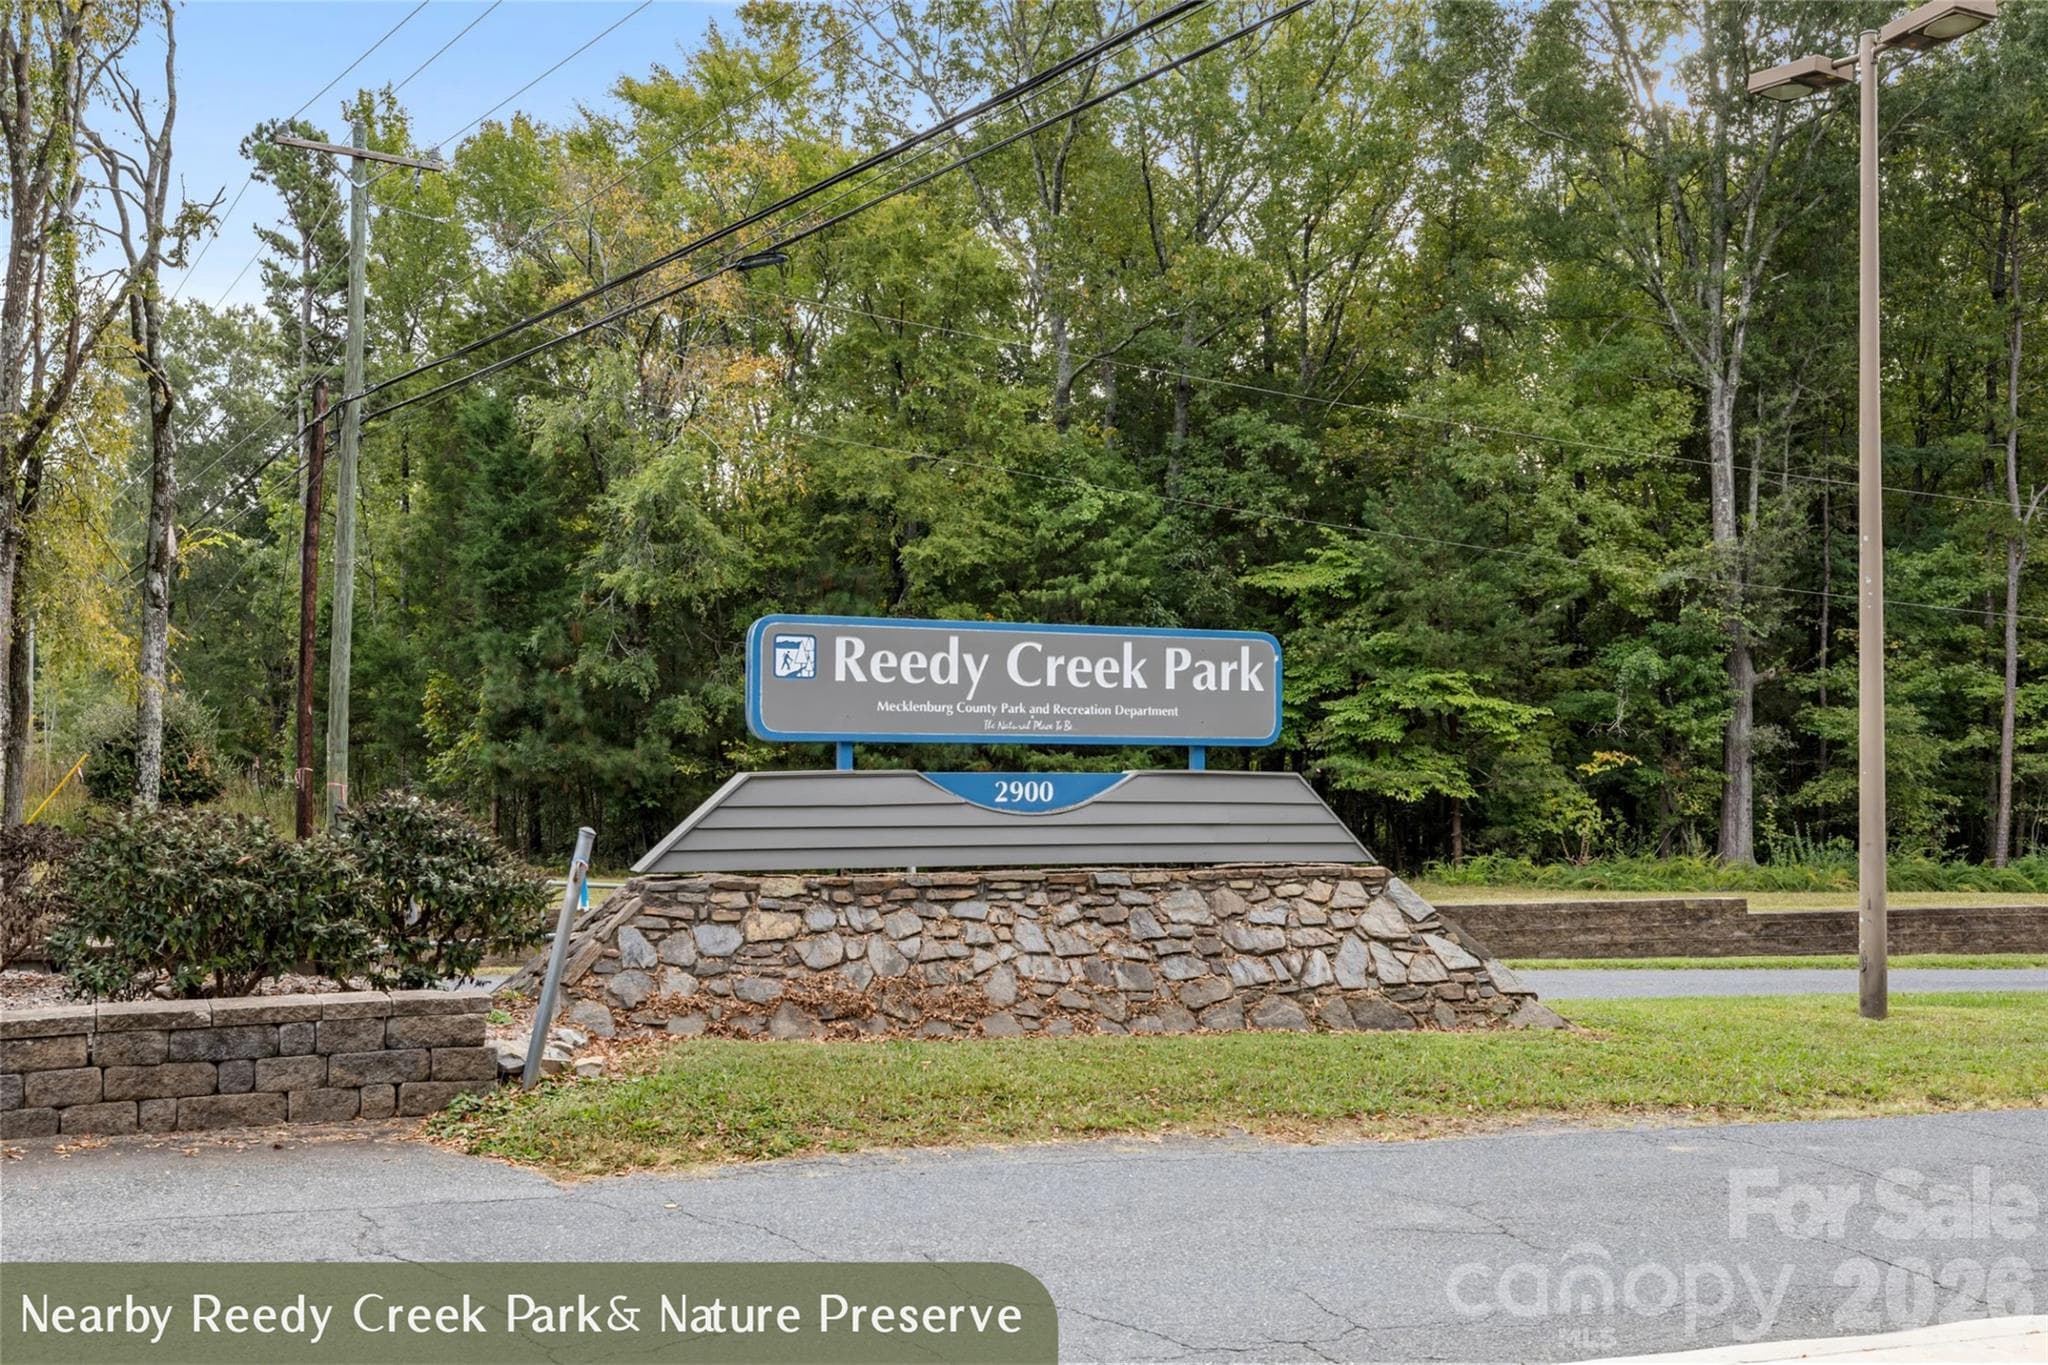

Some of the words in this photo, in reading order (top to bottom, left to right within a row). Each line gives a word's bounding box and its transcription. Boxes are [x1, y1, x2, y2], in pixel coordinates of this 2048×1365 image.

[834, 635, 990, 702] Reedy
[1006, 641, 1148, 689] Creek
[1165, 645, 1264, 692] Park
[876, 700, 953, 716] Mecklenburg
[956, 701, 997, 716] County
[1001, 702, 1026, 714] Park
[1029, 703, 1050, 715] and
[1053, 704, 1112, 716] Recreation
[1115, 704, 1179, 719] Department
[984, 719, 996, 730] The
[994, 780, 1054, 803] 2900
